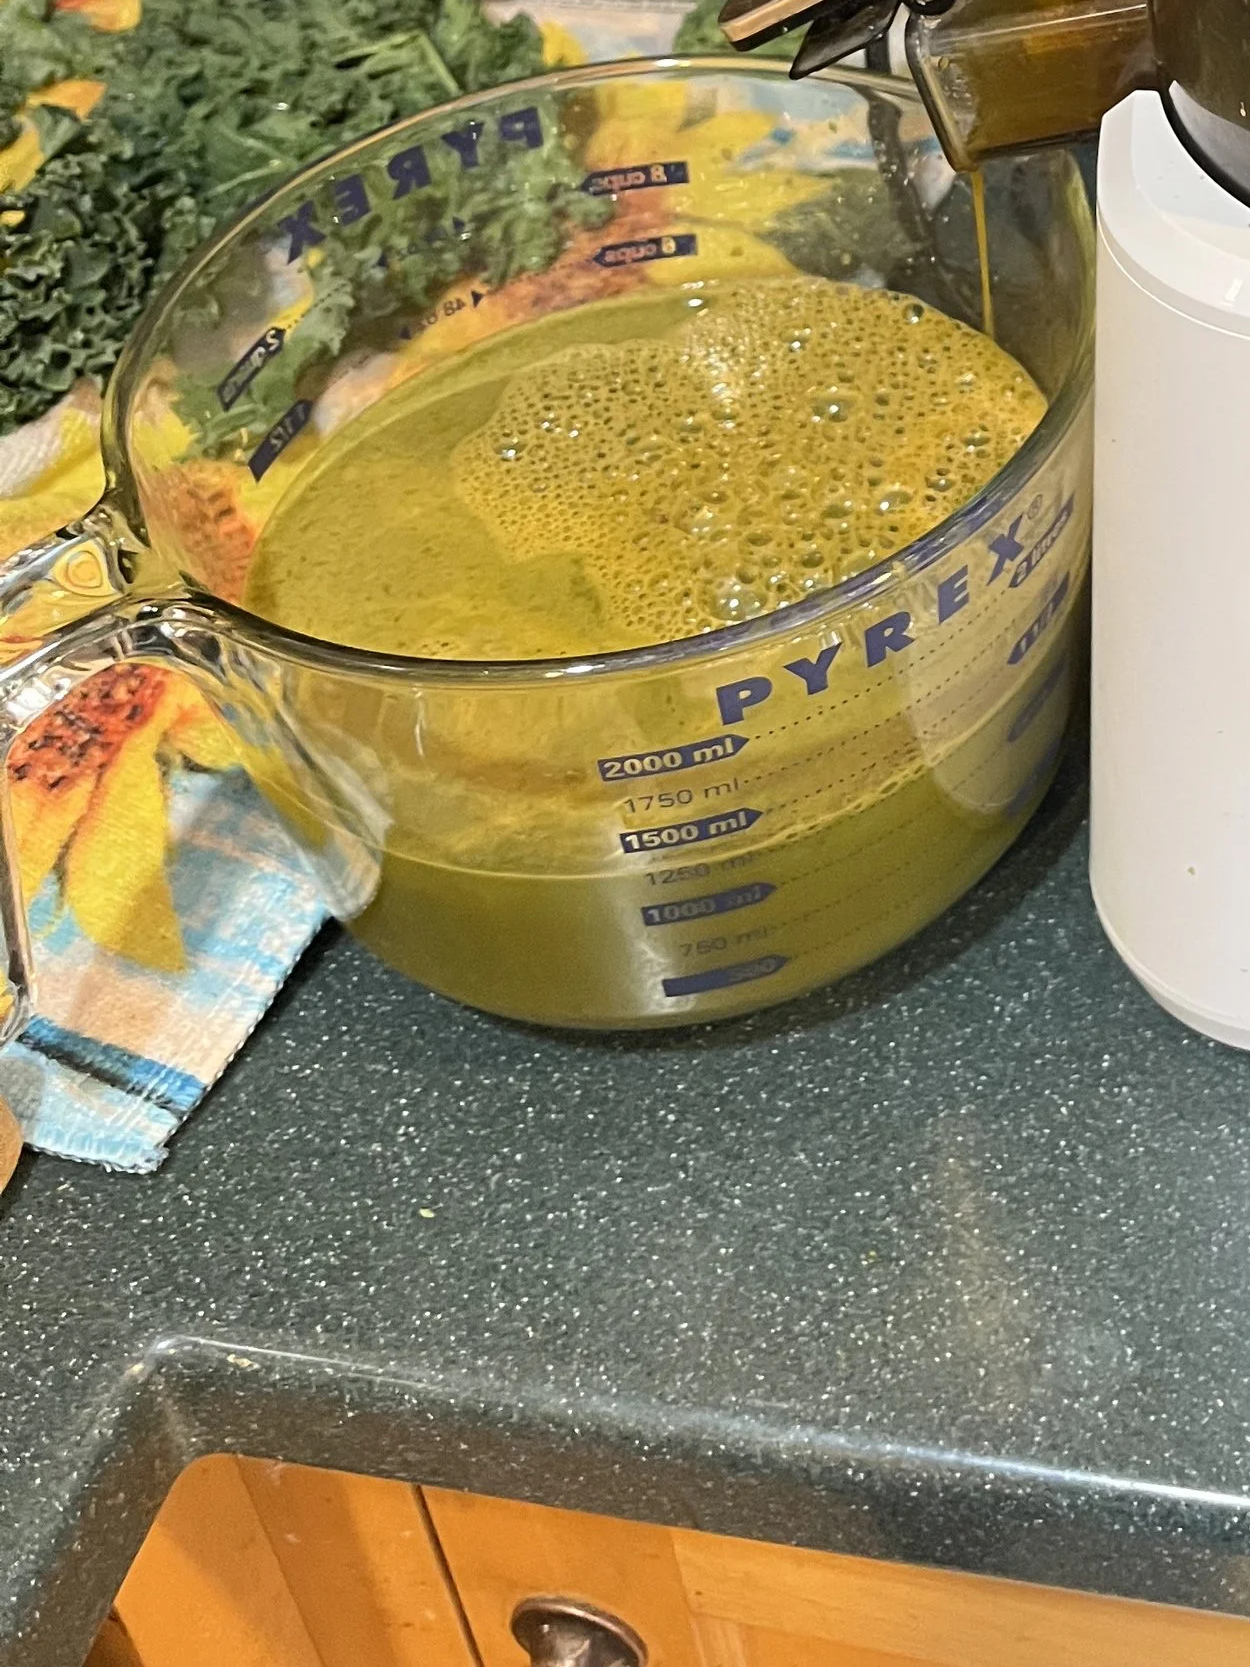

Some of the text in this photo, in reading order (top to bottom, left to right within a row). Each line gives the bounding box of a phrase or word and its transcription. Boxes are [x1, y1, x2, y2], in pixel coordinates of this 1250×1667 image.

[603, 737, 734, 778] 2000 ml
[624, 777, 739, 814] 1750 ml
[625, 811, 747, 850] 1500 ml
[647, 898, 716, 923] 1000
